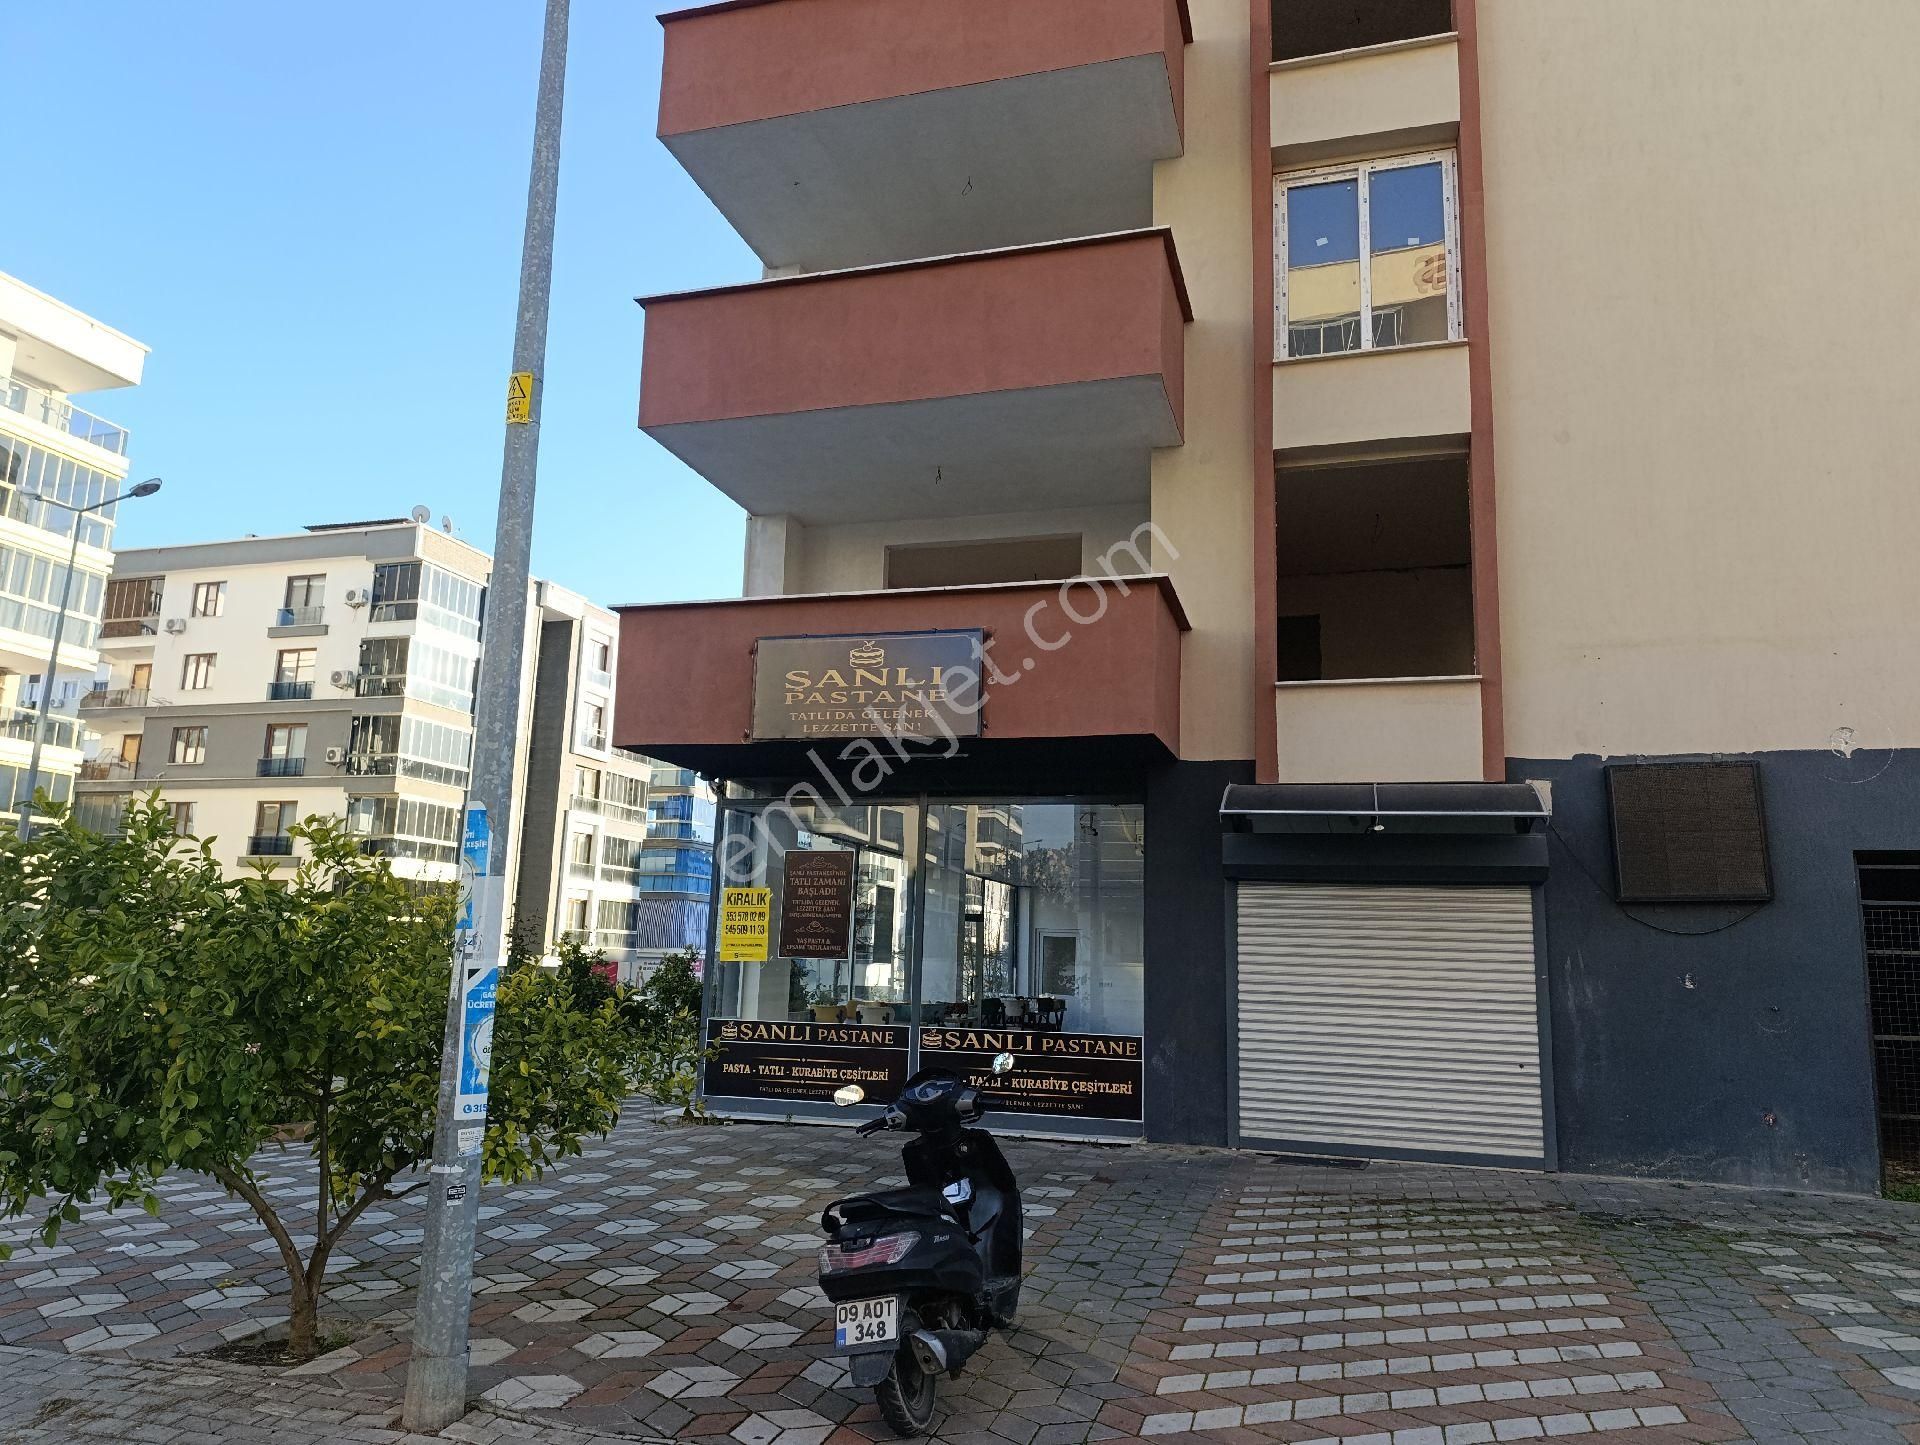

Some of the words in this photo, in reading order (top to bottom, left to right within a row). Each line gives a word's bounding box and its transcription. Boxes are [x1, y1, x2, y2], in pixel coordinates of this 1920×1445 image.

[783, 688, 949, 705] PASTANE
[790, 711, 830, 721] TATLI
[835, 711, 856, 720] DA
[803, 723, 877, 733] LEZZETTE
[790, 877, 811, 886] TATLI
[813, 877, 846, 886] ZAMANI
[725, 924, 737, 935] 545
[749, 924, 756, 935] 11
[740, 1023, 811, 1041] ŞANLI
[818, 1028, 894, 1044] PASTANE
[945, 1031, 1033, 1050] ŞANLI
[1042, 1039, 1138, 1056] PASTANE
[723, 1063, 750, 1074] PASTA
[758, 1065, 785, 1076] TATLI
[791, 1065, 838, 1079] KURABİYE
[839, 1067, 889, 1082] ÇEŞİTLERİ
[1011, 1076, 1069, 1091] KURABİYE
[1071, 1080, 1133, 1095] ÇEŞİTLERİ
[863, 1299, 894, 1320] AOT
[855, 1320, 886, 1341] 348
